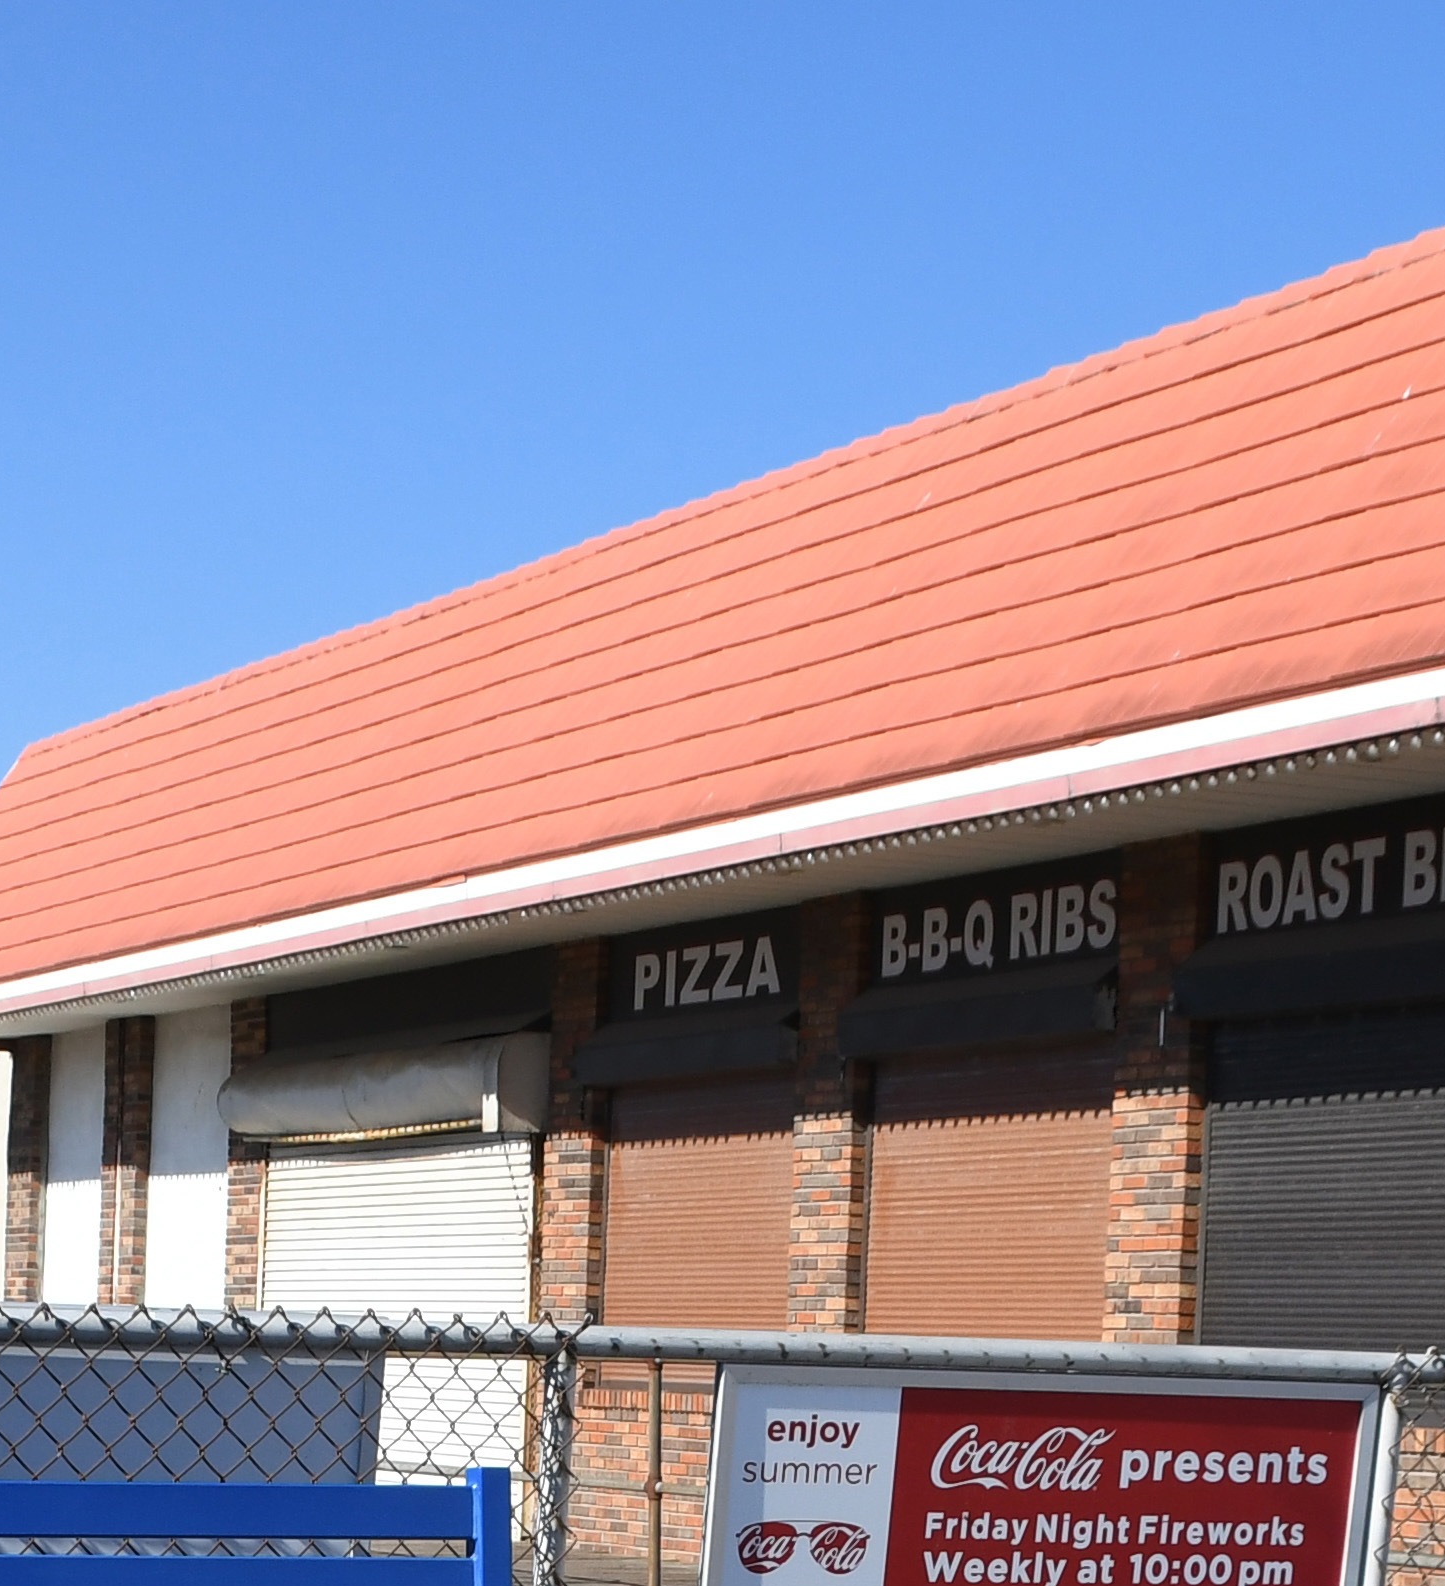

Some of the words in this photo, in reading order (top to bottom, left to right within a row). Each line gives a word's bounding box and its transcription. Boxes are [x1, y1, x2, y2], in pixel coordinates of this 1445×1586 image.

[1217, 836, 1387, 934] ROAST
[880, 899, 994, 978] B-B-Q
[1009, 881, 1118, 961] RIBS
[633, 936, 781, 1010] PIZZA
[767, 1414, 860, 1449] enjoy
[931, 1424, 1117, 1492] Coca-Cola
[1120, 1446, 1328, 1489] presents
[742, 1457, 878, 1487] summer
[925, 1511, 1028, 1545] Friday
[1036, 1514, 1130, 1549] Night
[1137, 1515, 1305, 1546] Fireworks
[1077, 1555, 1116, 1585] at
[1130, 1554, 1233, 1585] 10:00
